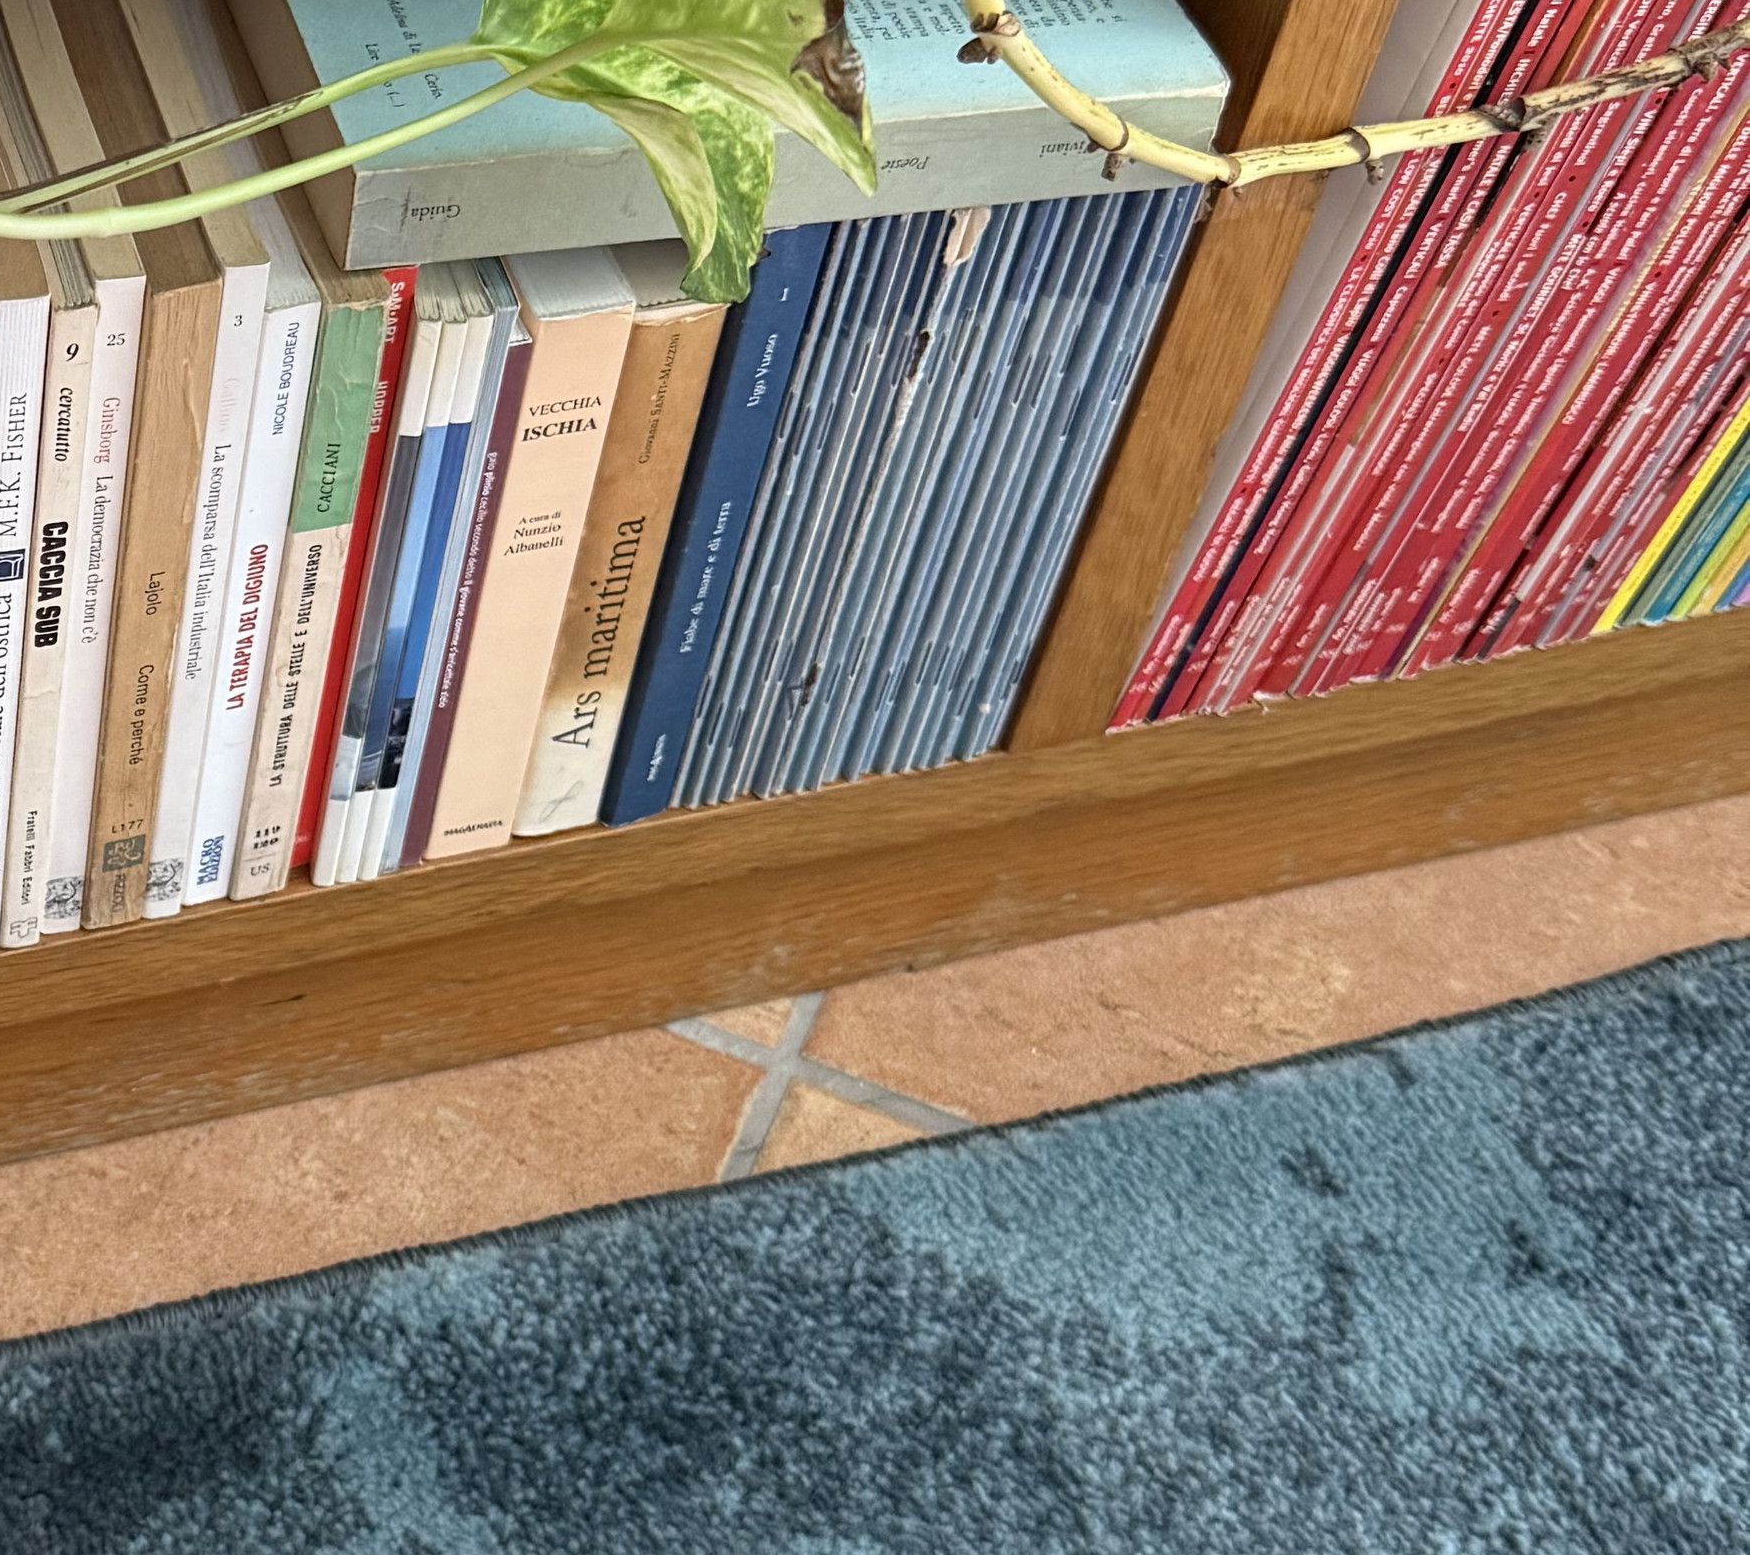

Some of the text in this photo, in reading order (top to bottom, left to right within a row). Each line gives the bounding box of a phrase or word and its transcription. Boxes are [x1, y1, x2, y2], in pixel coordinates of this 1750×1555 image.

[881, 155, 931, 171] Poesie
[1478, 140, 1512, 188] NATALE
[410, 201, 463, 221] Guida
[233, 315, 243, 327] 3
[65, 343, 79, 362] 9
[106, 333, 126, 347] 25
[272, 322, 300, 436] NICOLE BOUDREAU
[529, 396, 602, 417] VECCHIA
[521, 417, 597, 442] ISCHIA
[88, 397, 121, 573] Ginsborg democrazia
[317, 443, 341, 514] CACCIANI
[203, 464, 224, 541] scomparsa
[504, 536, 564, 556] Albanelli
[513, 523, 562, 539] Nunzio
[34, 521, 69, 648] CACCIA SUB
[226, 543, 269, 711] LA TERAPIA DEL DIGIUNO
[680, 564, 714, 654] Fiabe mare
[551, 515, 646, 749] Ars maritima
[129, 571, 166, 766] Lajolo Come perché
[271, 544, 322, 777] STRUTTURA DELLE STELLE DELL'UNIVERSO
[111, 819, 144, 834] L177
[250, 862, 270, 876] US
